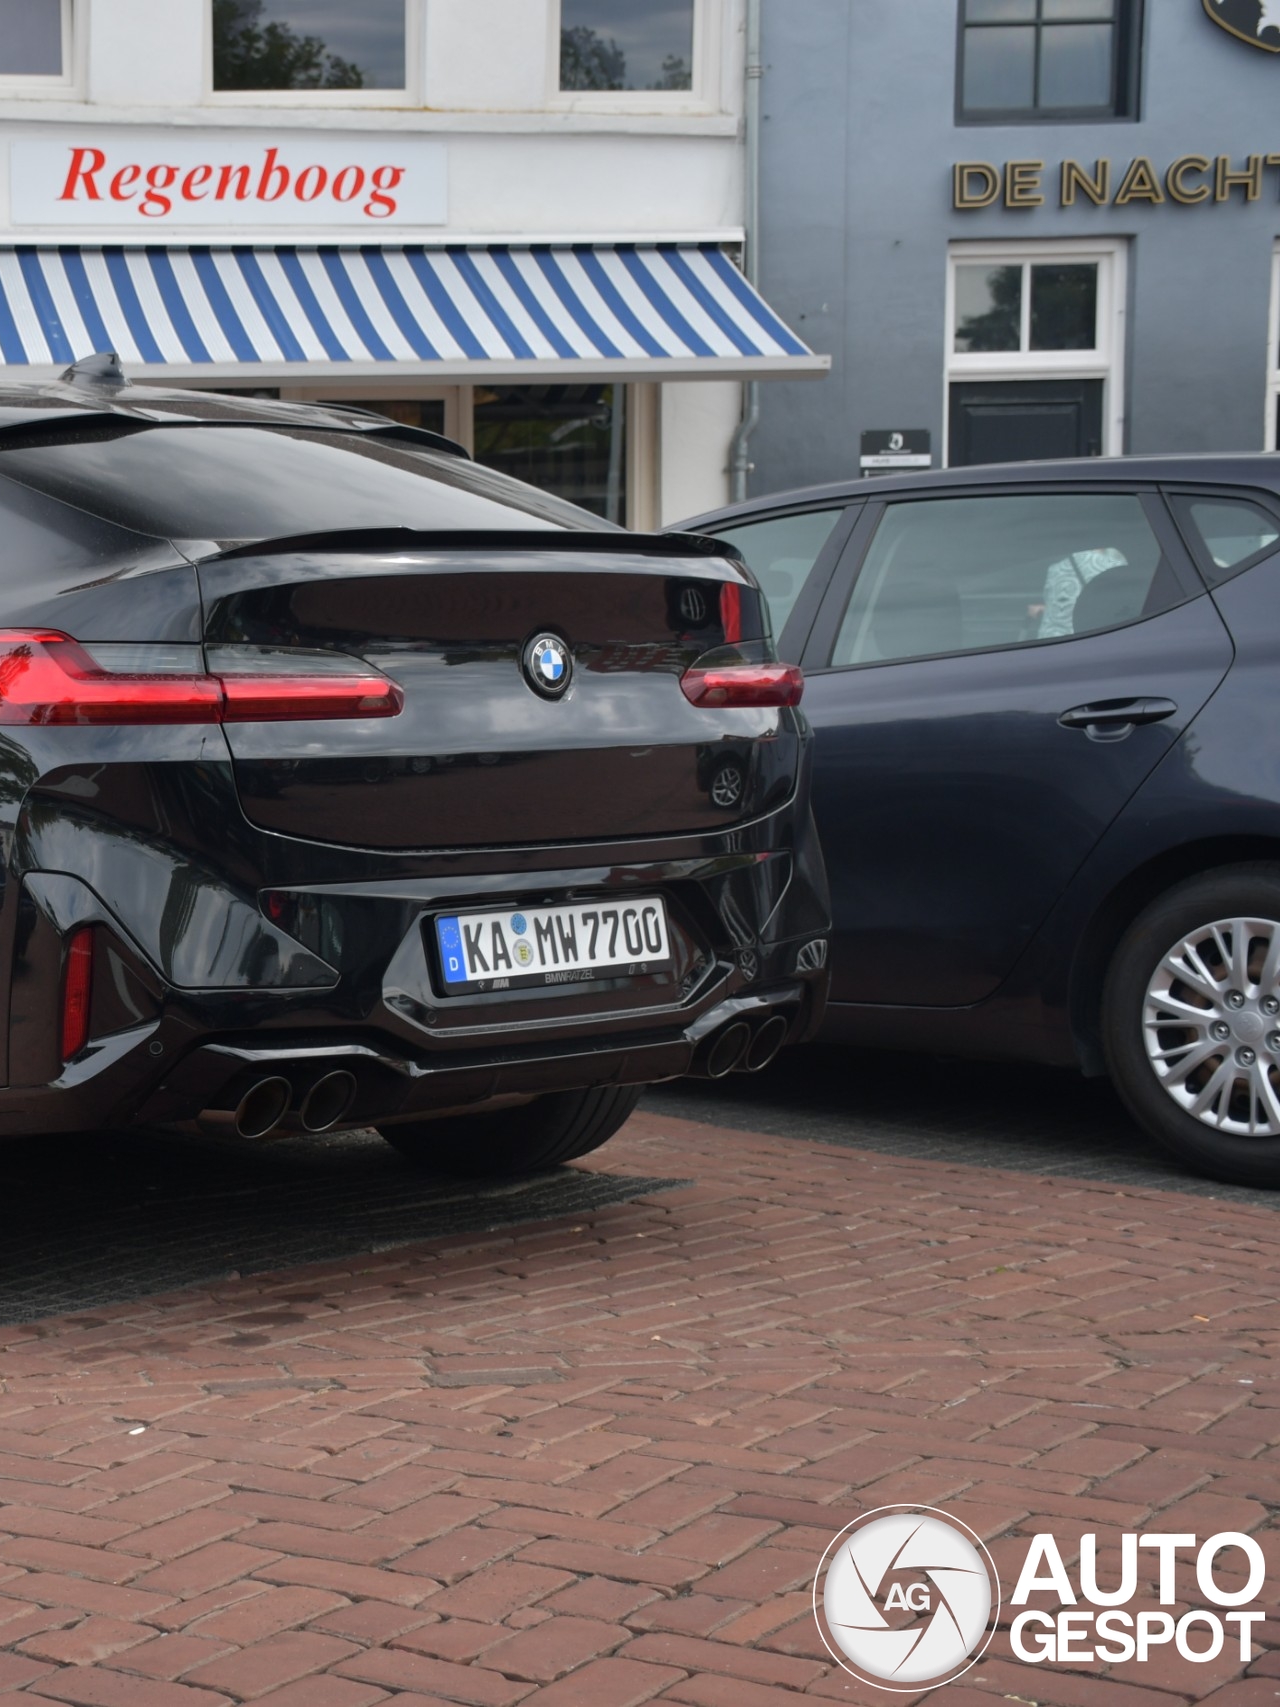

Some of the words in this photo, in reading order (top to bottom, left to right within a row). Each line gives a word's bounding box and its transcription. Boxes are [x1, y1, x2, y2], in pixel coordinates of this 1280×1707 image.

[55, 146, 406, 219] Regenboog
[953, 160, 1044, 208] DE
[534, 640, 566, 657] BMW
[449, 956, 459, 972] D
[463, 922, 512, 973] KA
[534, 914, 578, 965] MW
[582, 907, 662, 959] 7700
